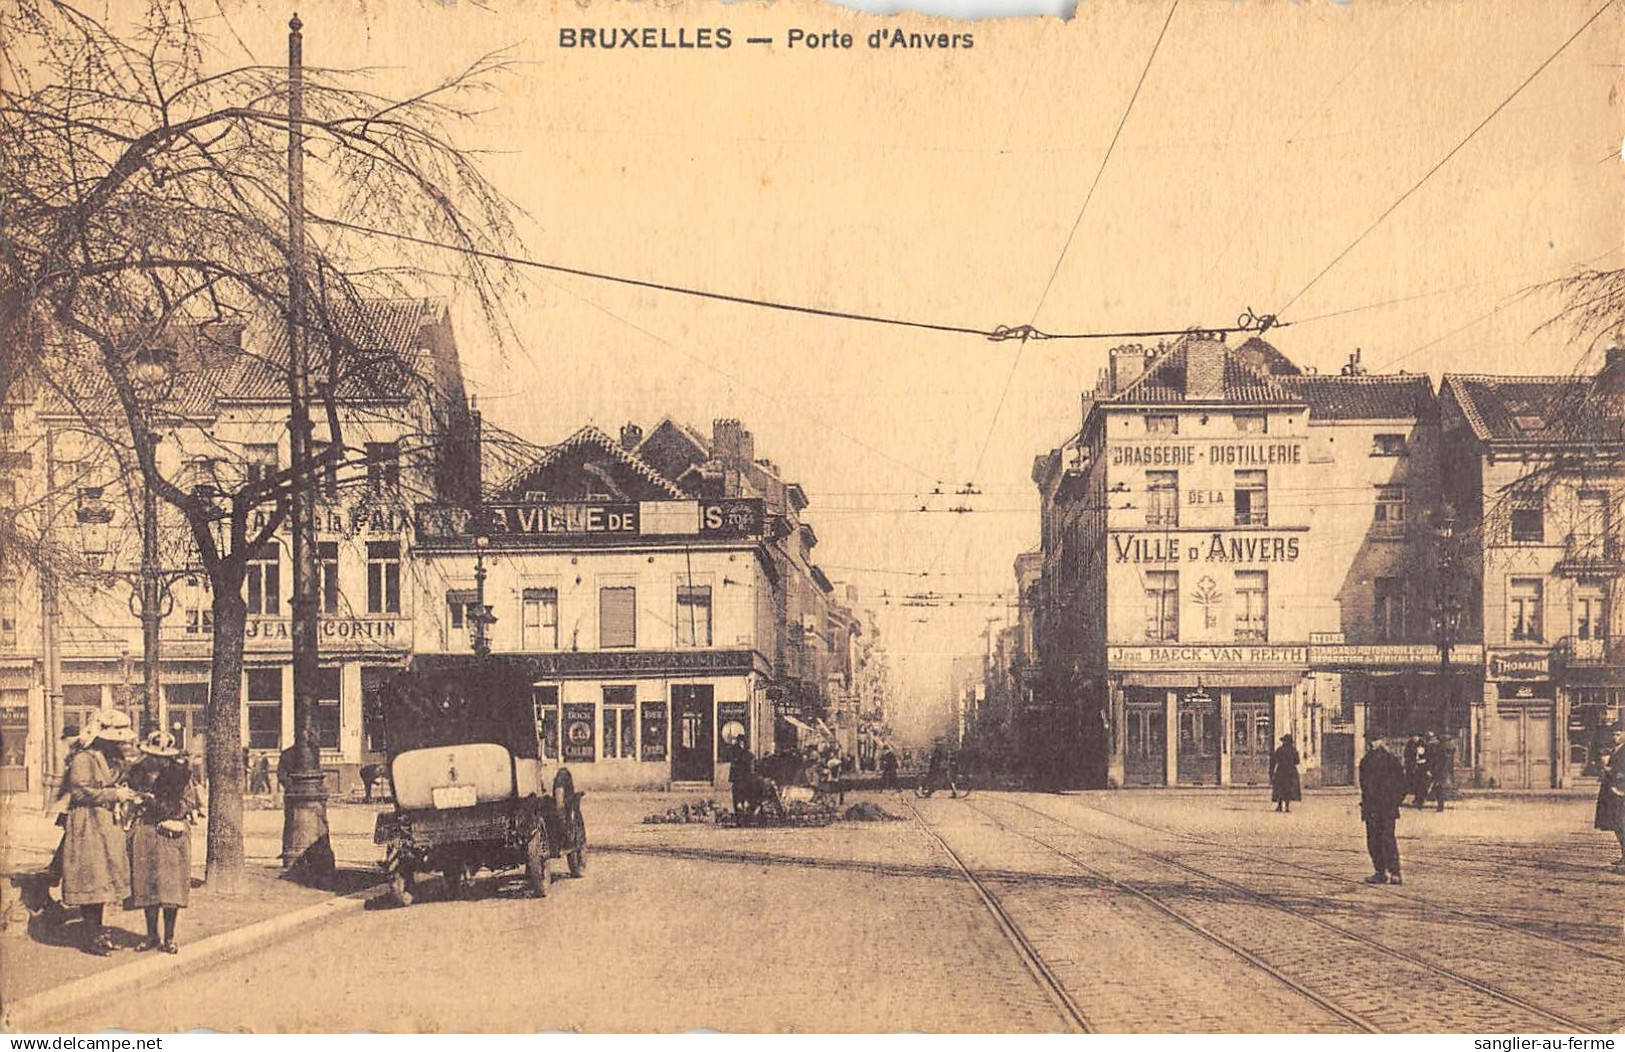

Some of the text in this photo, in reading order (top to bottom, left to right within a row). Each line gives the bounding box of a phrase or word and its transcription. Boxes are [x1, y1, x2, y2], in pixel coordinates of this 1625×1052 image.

[1113, 444, 1301, 465] BRASSERIE DISTILLERIE
[1188, 491, 1224, 504] DE LA
[517, 504, 605, 532] VILLE
[608, 512, 635, 531] DE
[1112, 534, 1180, 563] VILLE
[246, 620, 396, 639] JEA CORTIN
[1250, 648, 1302, 662] REETH
